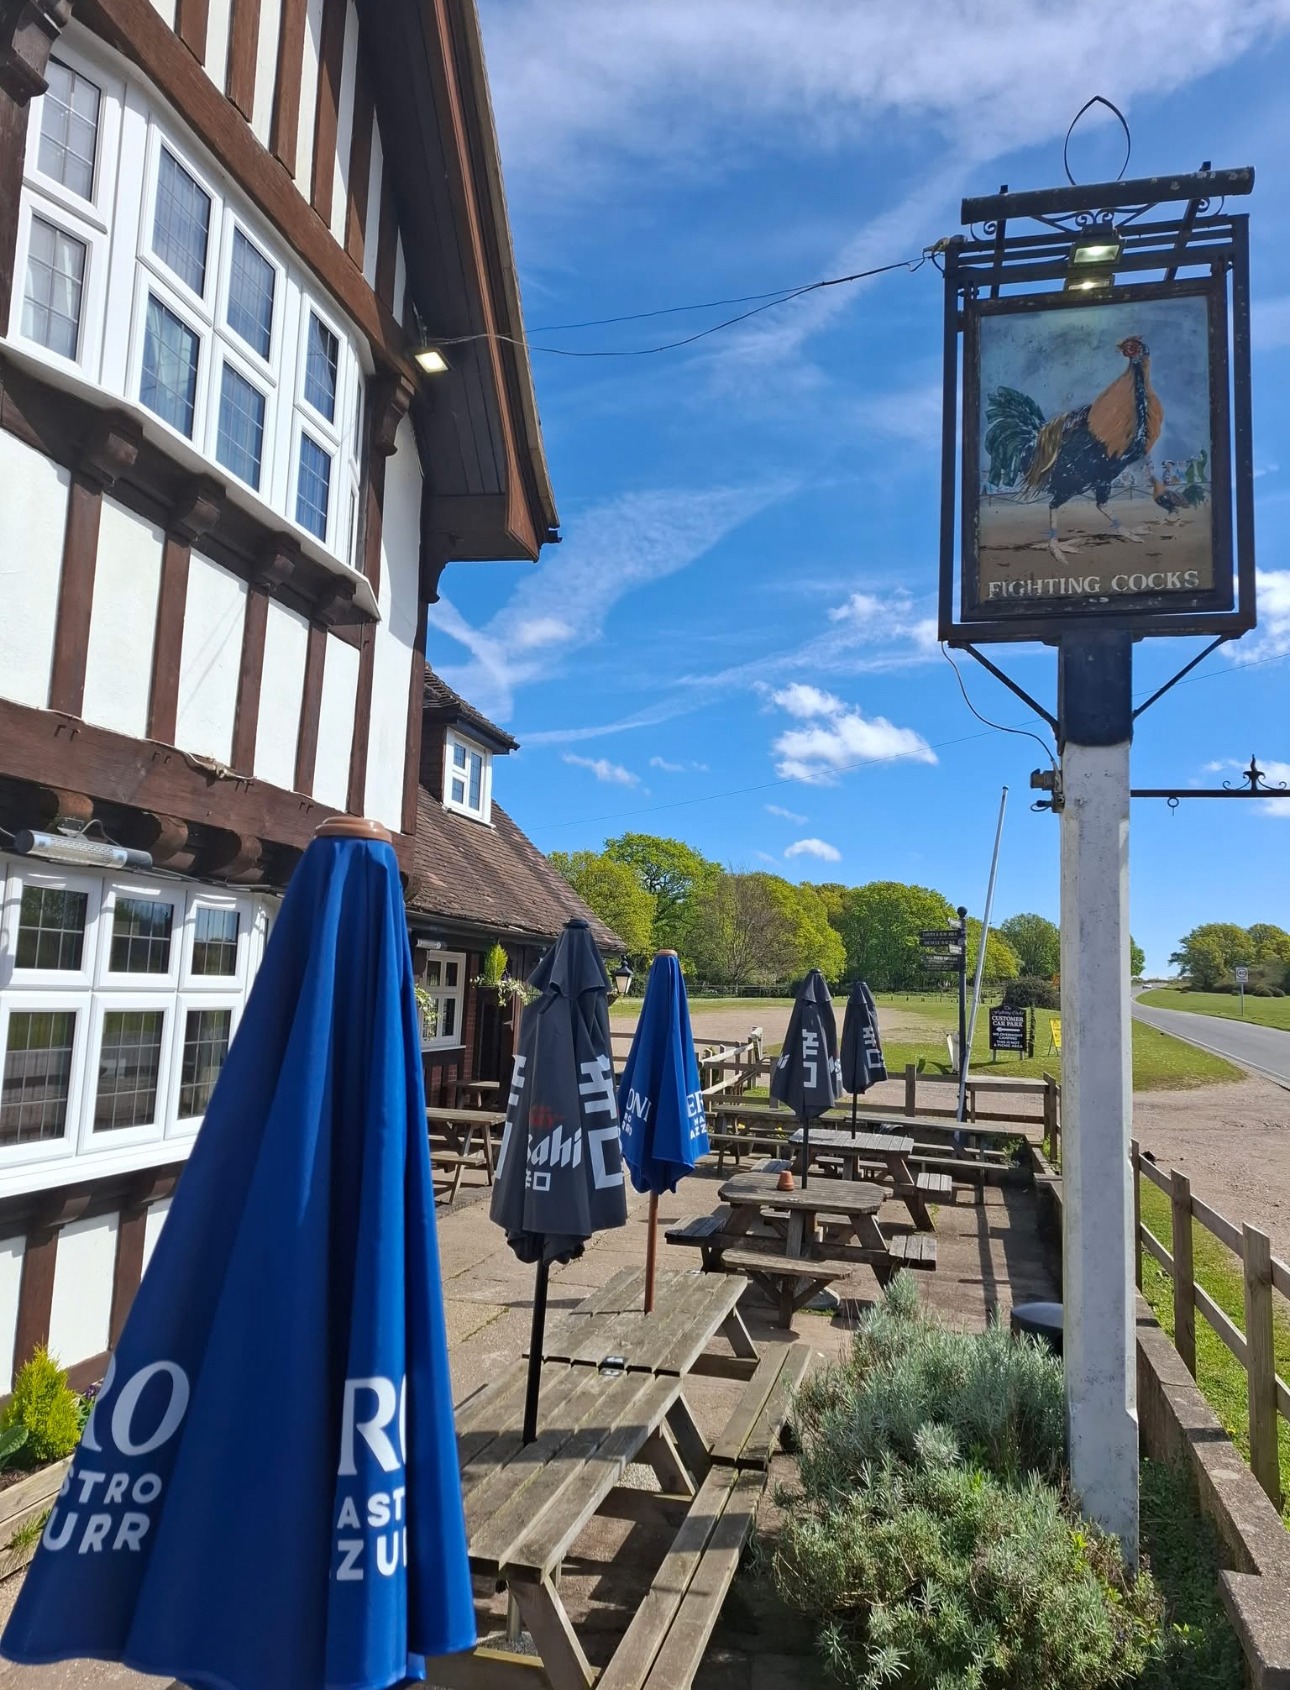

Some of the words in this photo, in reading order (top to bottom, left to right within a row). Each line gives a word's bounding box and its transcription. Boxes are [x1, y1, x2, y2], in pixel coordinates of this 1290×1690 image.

[988, 576, 1101, 598] FIGHTING
[1111, 570, 1200, 592] COCKS
[527, 1124, 582, 1169] ahi
[337, 1374, 406, 1475] R
[336, 1526, 407, 1581] ZU
